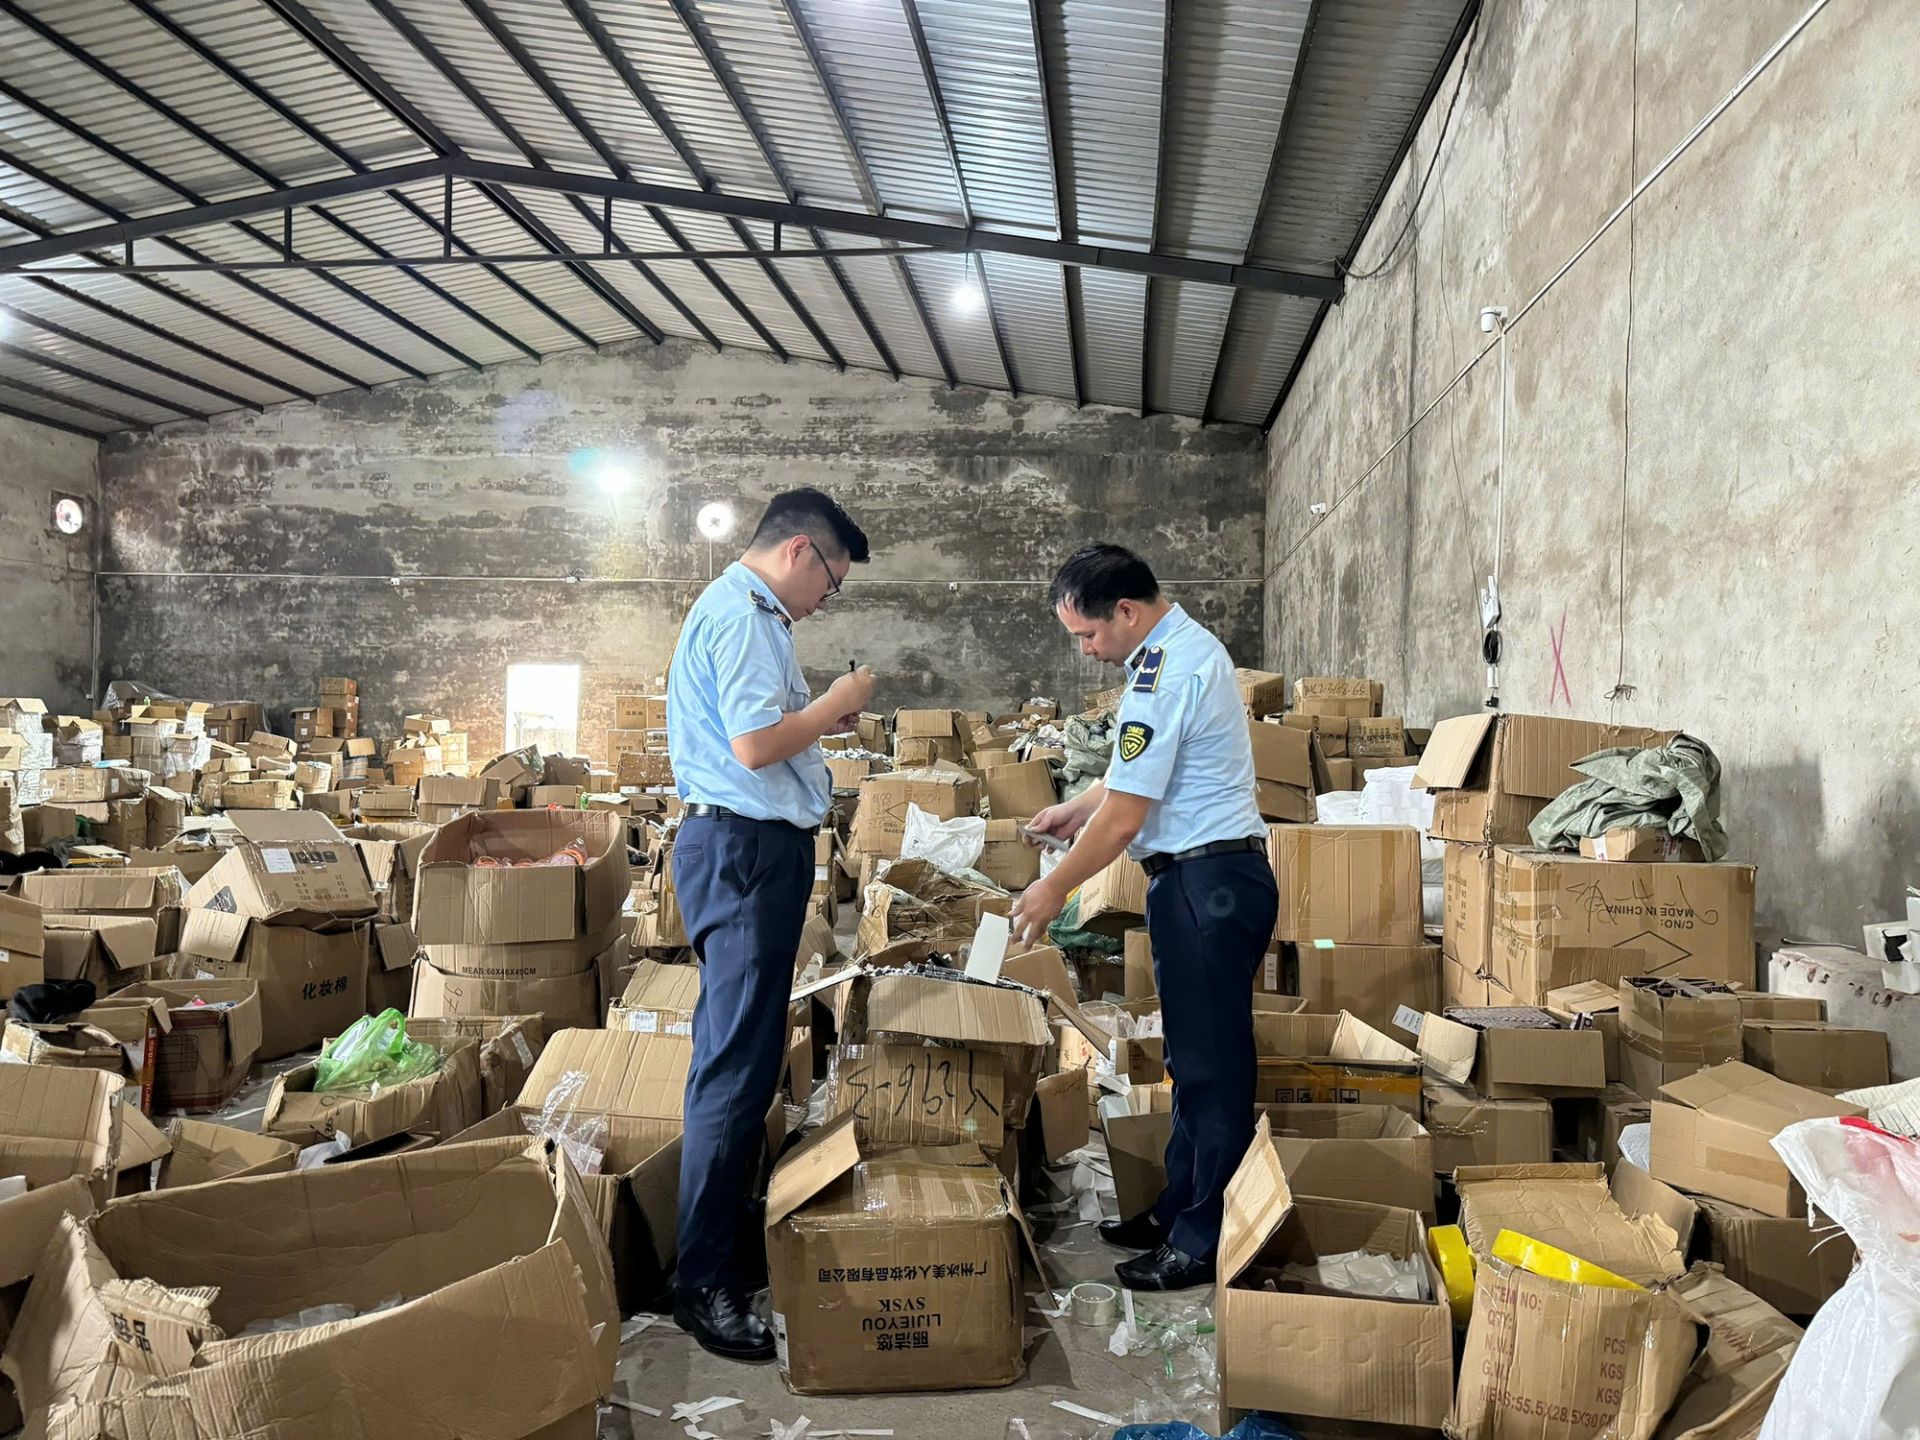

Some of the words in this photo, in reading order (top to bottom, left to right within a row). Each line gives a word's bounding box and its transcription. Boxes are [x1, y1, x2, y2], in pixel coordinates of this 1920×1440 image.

[1126, 725, 1145, 736] DMS
[1606, 904, 1642, 915] CHINA
[1646, 906, 1658, 916] IN
[1660, 907, 1694, 918] MADE
[1660, 919, 1694, 930] C/NO:
[302, 976, 347, 1000] 化妆棉
[818, 1261, 988, 1283] 广州冰美人化妆品有限公司
[878, 1296, 926, 1312] SVSK
[1491, 1285, 1517, 1305] ITEM
[1520, 1292, 1542, 1312] NO:
[862, 1313, 941, 1331] LIJIEYOU
[1487, 1309, 1513, 1329] QTY:
[876, 1331, 929, 1351] 丽洁悠
[1603, 1337, 1627, 1355] PCS
[1600, 1361, 1624, 1380] KGS
[1596, 1386, 1621, 1406] KGS
